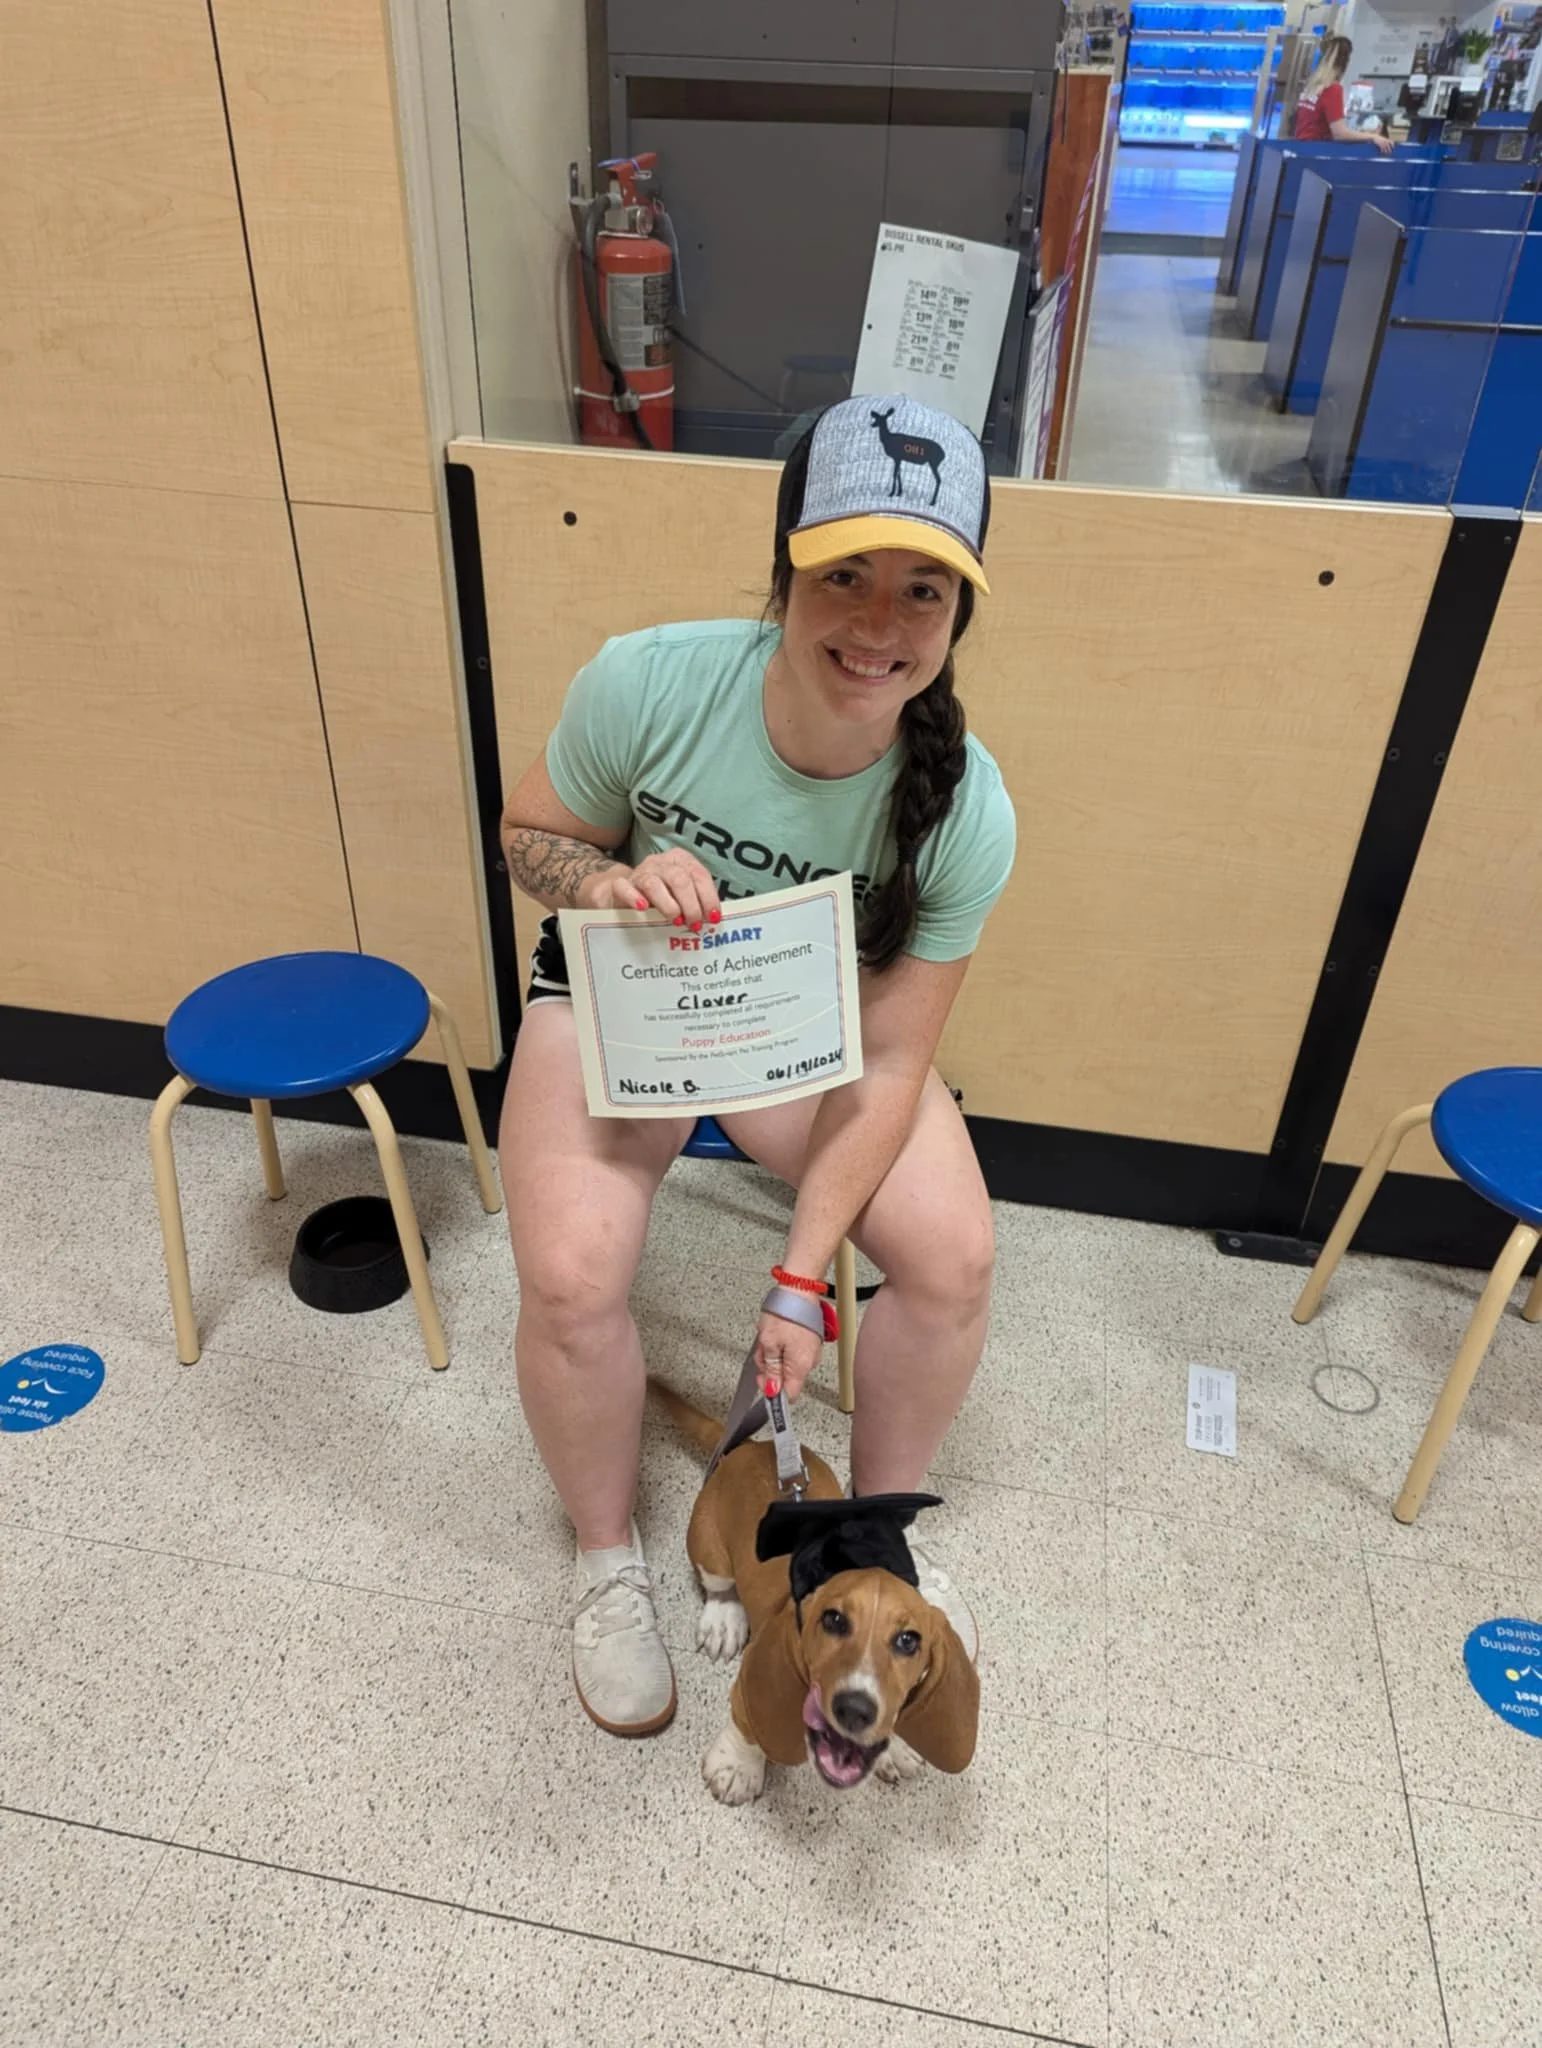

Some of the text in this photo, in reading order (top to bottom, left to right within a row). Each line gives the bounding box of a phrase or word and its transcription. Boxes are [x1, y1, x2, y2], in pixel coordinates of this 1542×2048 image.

[916, 235, 944, 249] RENTAL
[621, 943, 813, 980] Certificate of Achievement
[680, 974, 763, 992] This certifies that
[644, 1013, 657, 1021] has
[659, 1011, 701, 1021] successfully
[703, 1006, 743, 1018] completed
[754, 994, 801, 1009] requirements
[684, 1023, 720, 1031] necessary
[732, 1015, 766, 1027] complete
[681, 1029, 771, 1048] Puppy Education
[619, 1078, 674, 1095] Nicole
[43, 1350, 90, 1364] required
[20, 1356, 96, 1380] Face covering
[8, 1394, 49, 1409] six feet
[1479, 1635, 1541, 1657] covering
[1501, 1702, 1540, 1718] allow
